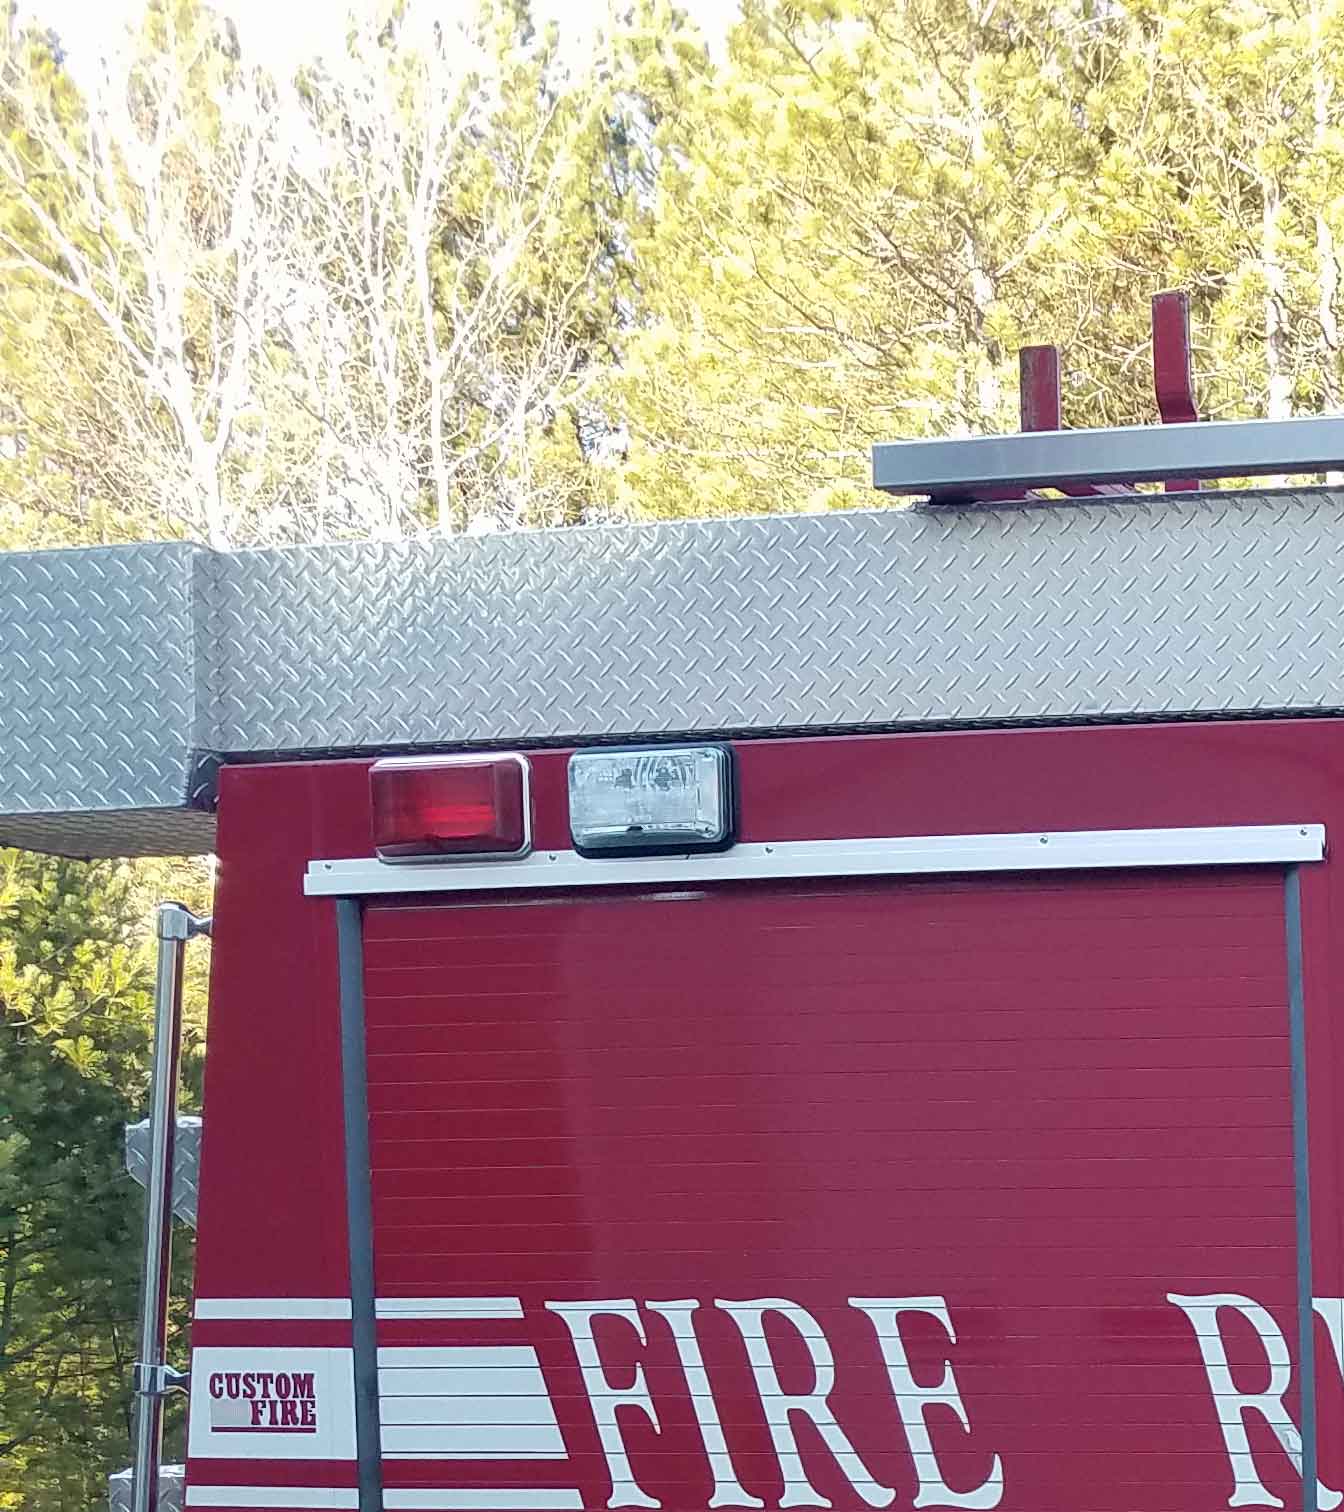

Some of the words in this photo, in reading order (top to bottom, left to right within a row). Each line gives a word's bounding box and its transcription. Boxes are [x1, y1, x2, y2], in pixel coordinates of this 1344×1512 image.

[209, 1373, 316, 1399] CUSTOM
[250, 1399, 317, 1426] FIRE
[544, 1295, 1004, 1511] FIRE
